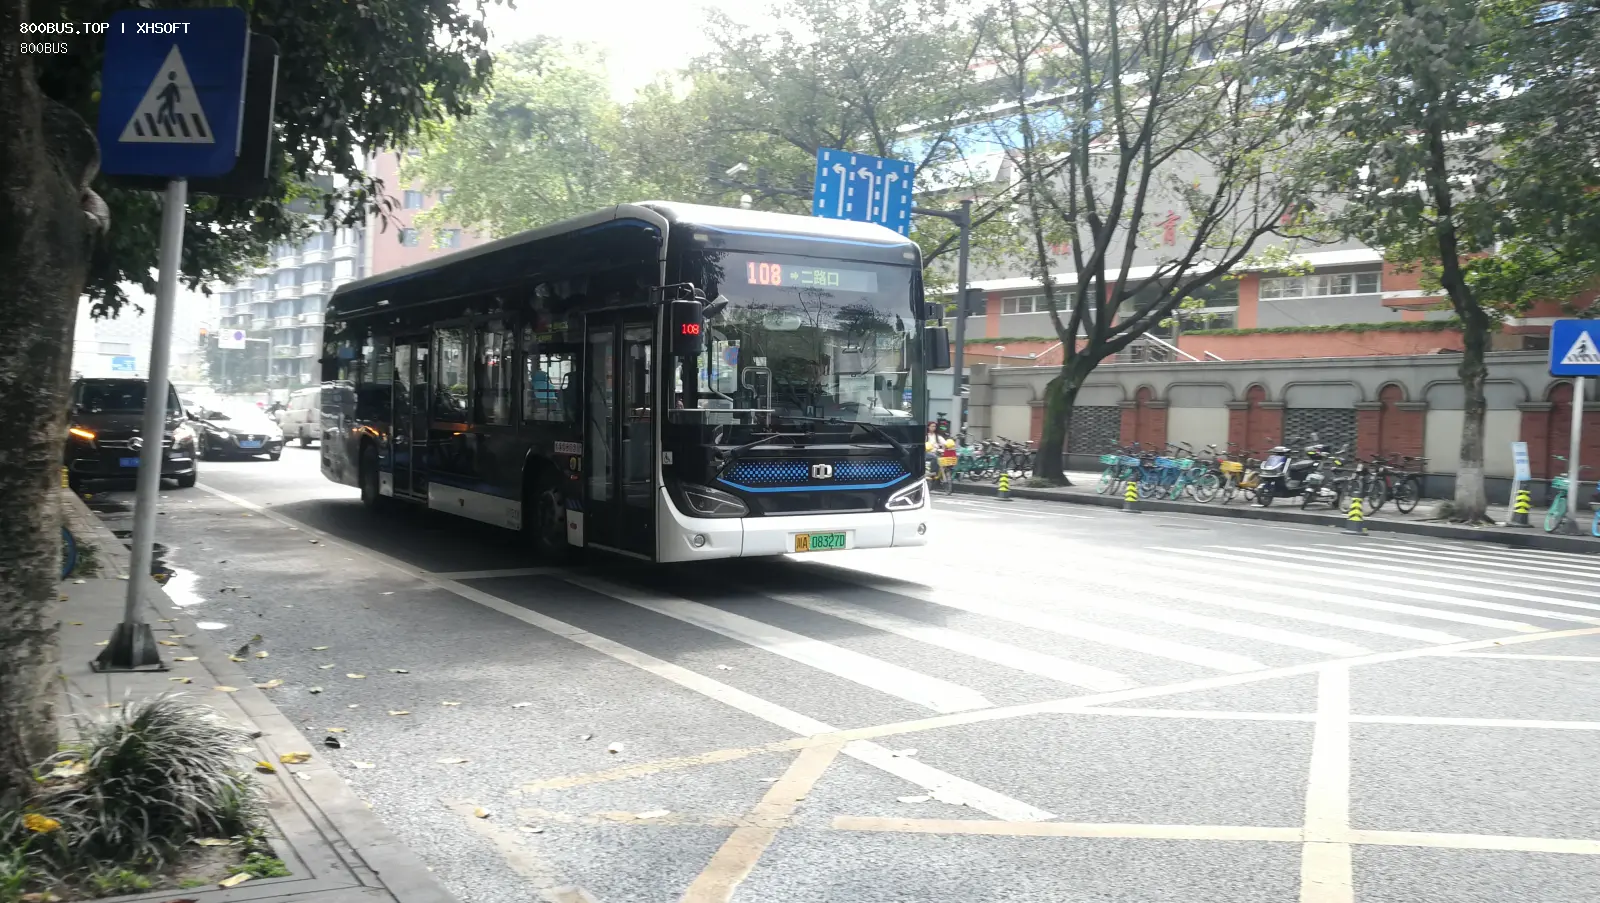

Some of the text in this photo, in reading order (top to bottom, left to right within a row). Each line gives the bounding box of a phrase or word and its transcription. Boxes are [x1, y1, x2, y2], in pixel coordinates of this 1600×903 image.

[747, 261, 840, 287] 108 二路口
[681, 323, 700, 335] 108
